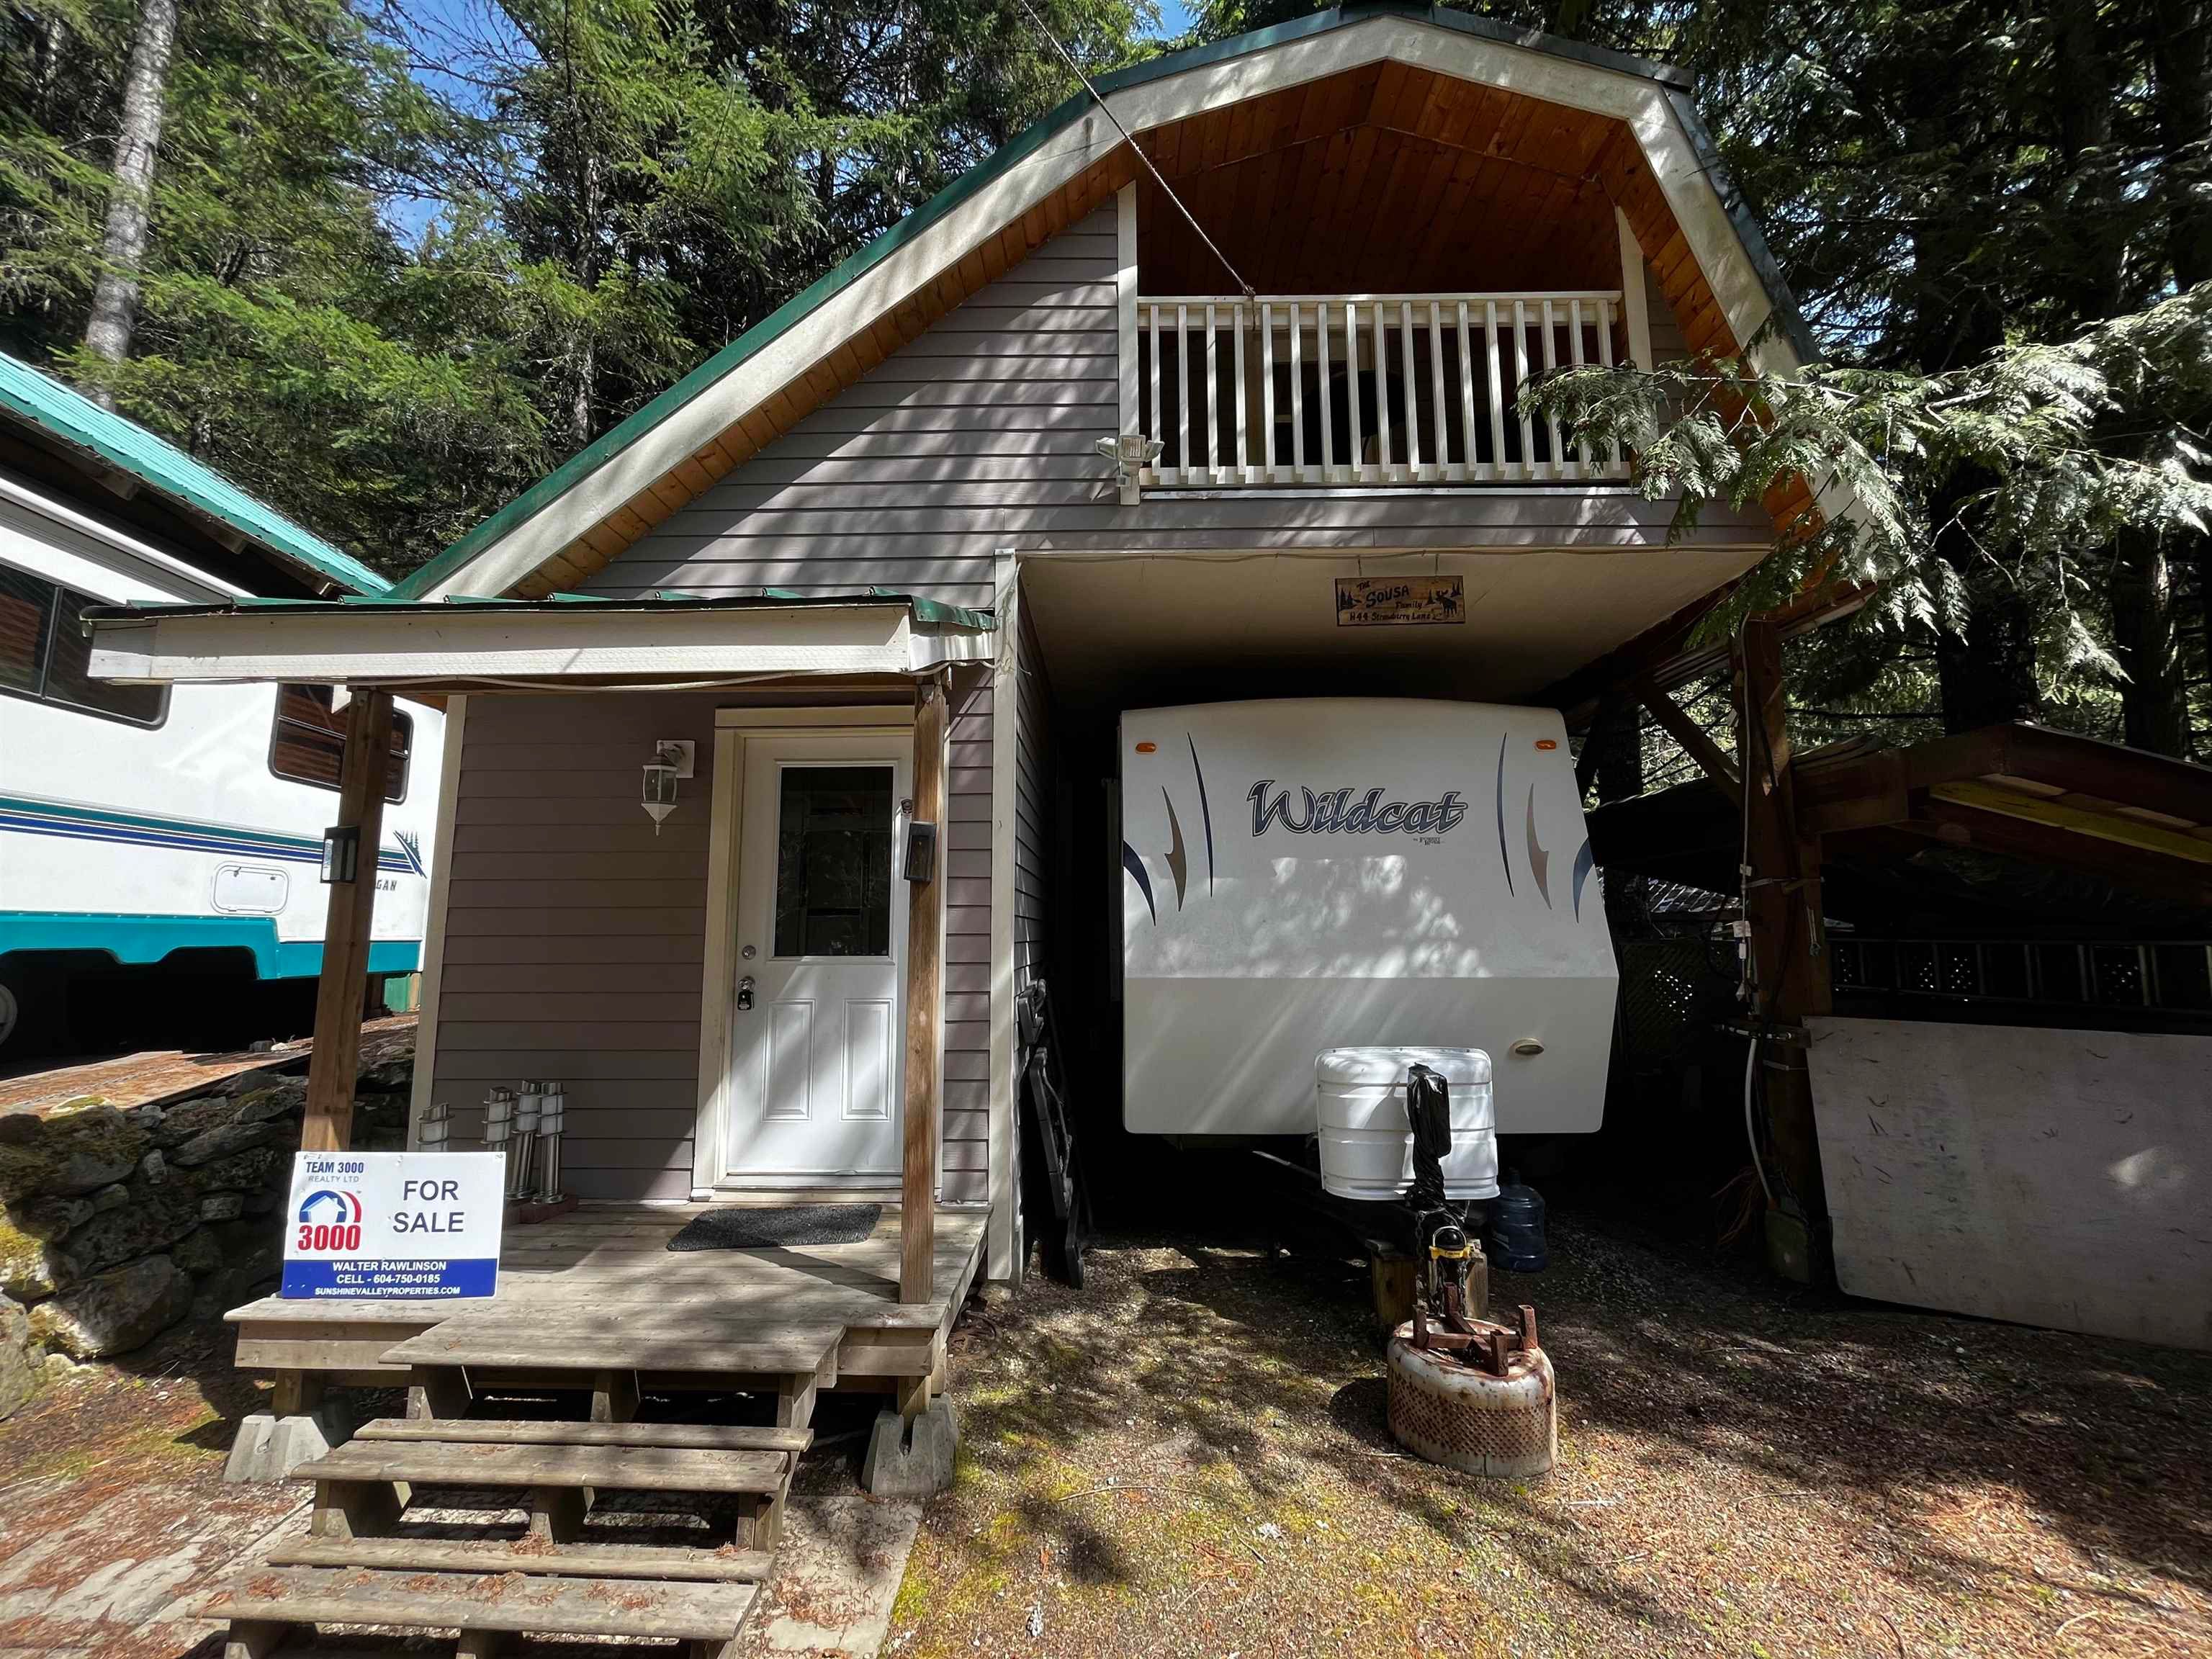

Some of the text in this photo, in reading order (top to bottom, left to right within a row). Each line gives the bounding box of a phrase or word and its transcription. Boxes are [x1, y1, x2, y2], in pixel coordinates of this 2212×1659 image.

[1371, 612, 1411, 621] Strberry
[1246, 780, 1469, 837] Wildcat
[306, 1161, 364, 1173] TEAM 3000
[403, 1180, 459, 1201] FOR
[392, 1212, 465, 1233] SALE
[298, 1225, 361, 1251] 3000
[333, 1261, 446, 1272] WALTER RAWLINSON
[336, 1274, 365, 1283] CELL
[373, 1274, 441, 1283] 604-750-0185
[315, 1287, 461, 1295] SUNSHINEVALLEYPROPERTIES.COM
